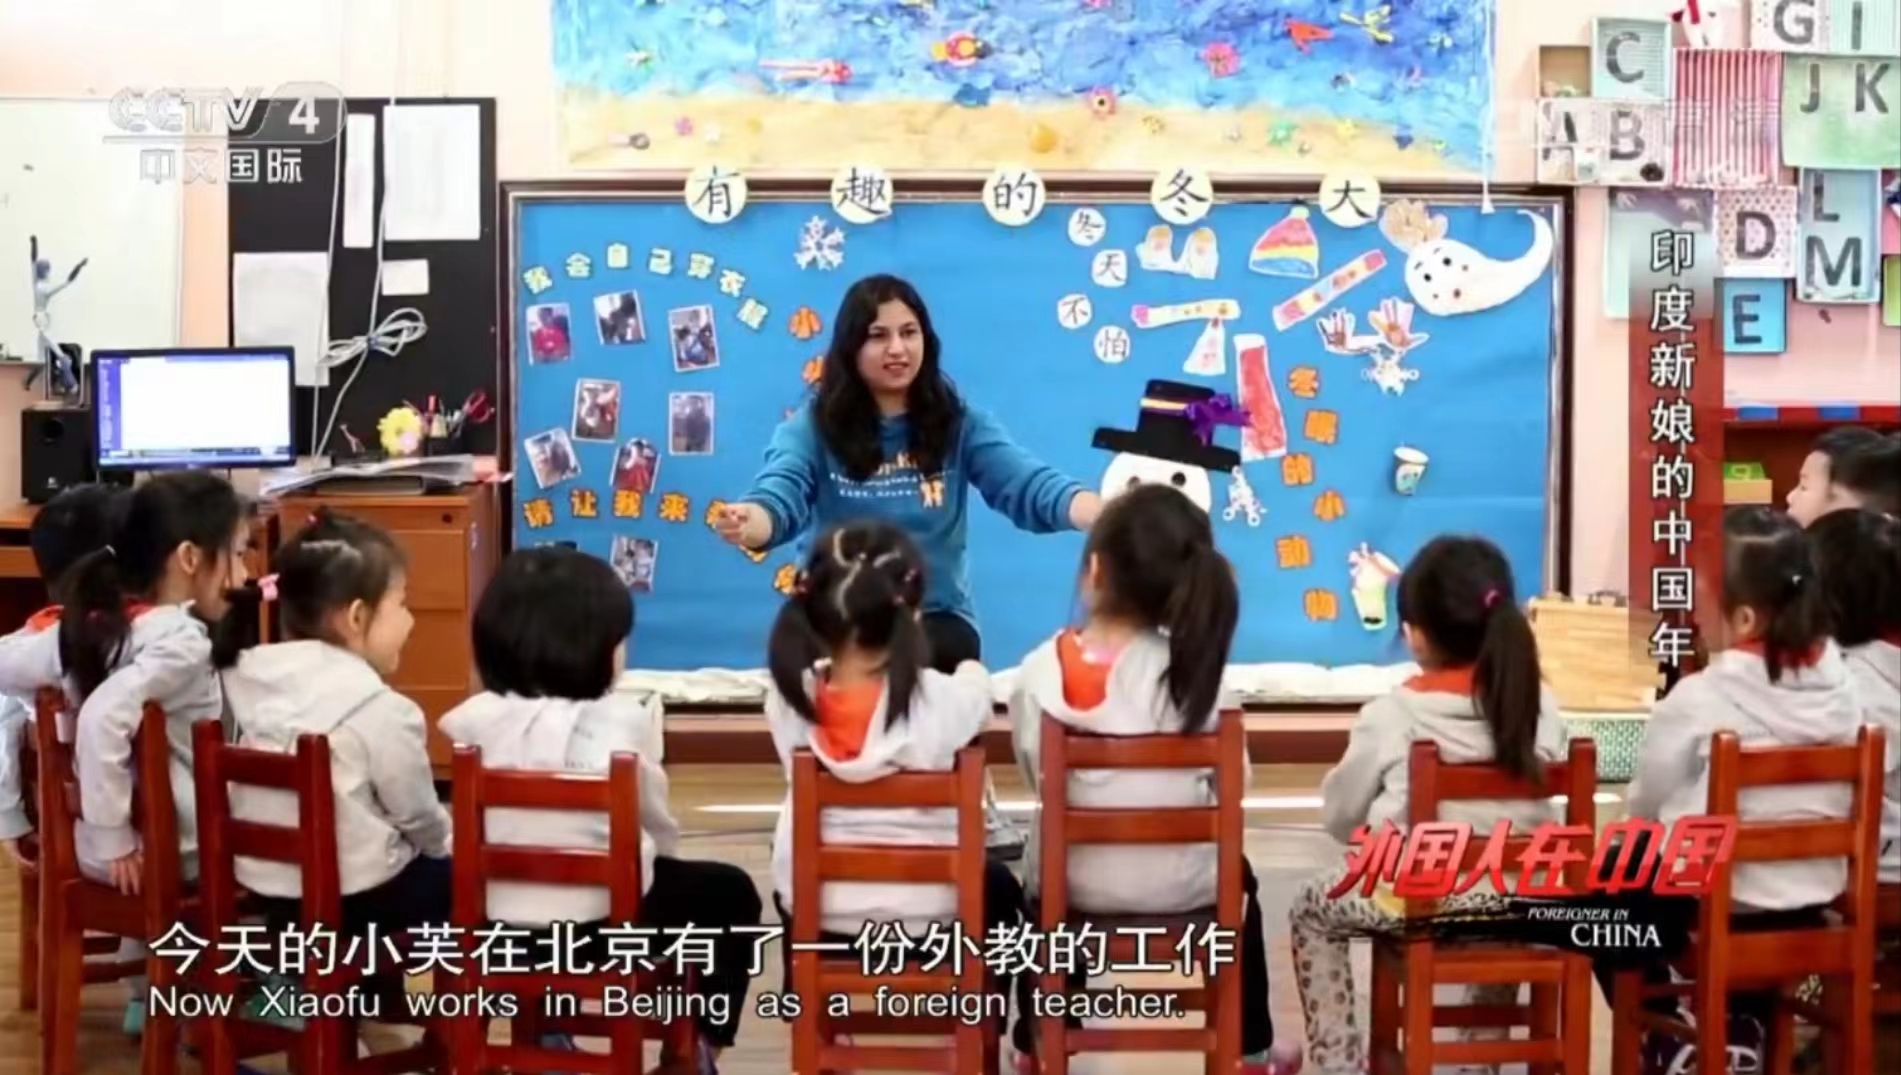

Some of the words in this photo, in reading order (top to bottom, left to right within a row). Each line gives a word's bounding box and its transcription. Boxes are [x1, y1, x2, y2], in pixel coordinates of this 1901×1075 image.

[1773, 0, 1815, 45] G
[1851, 0, 1863, 51] I
[1605, 31, 1645, 84] C
[1799, 63, 1821, 114] J
[1854, 63, 1891, 114] K
[1609, 109, 1647, 161] B
[1812, 170, 1841, 223] L
[1735, 210, 1777, 260] D
[1804, 235, 1864, 288] M
[1732, 293, 1763, 345] E
